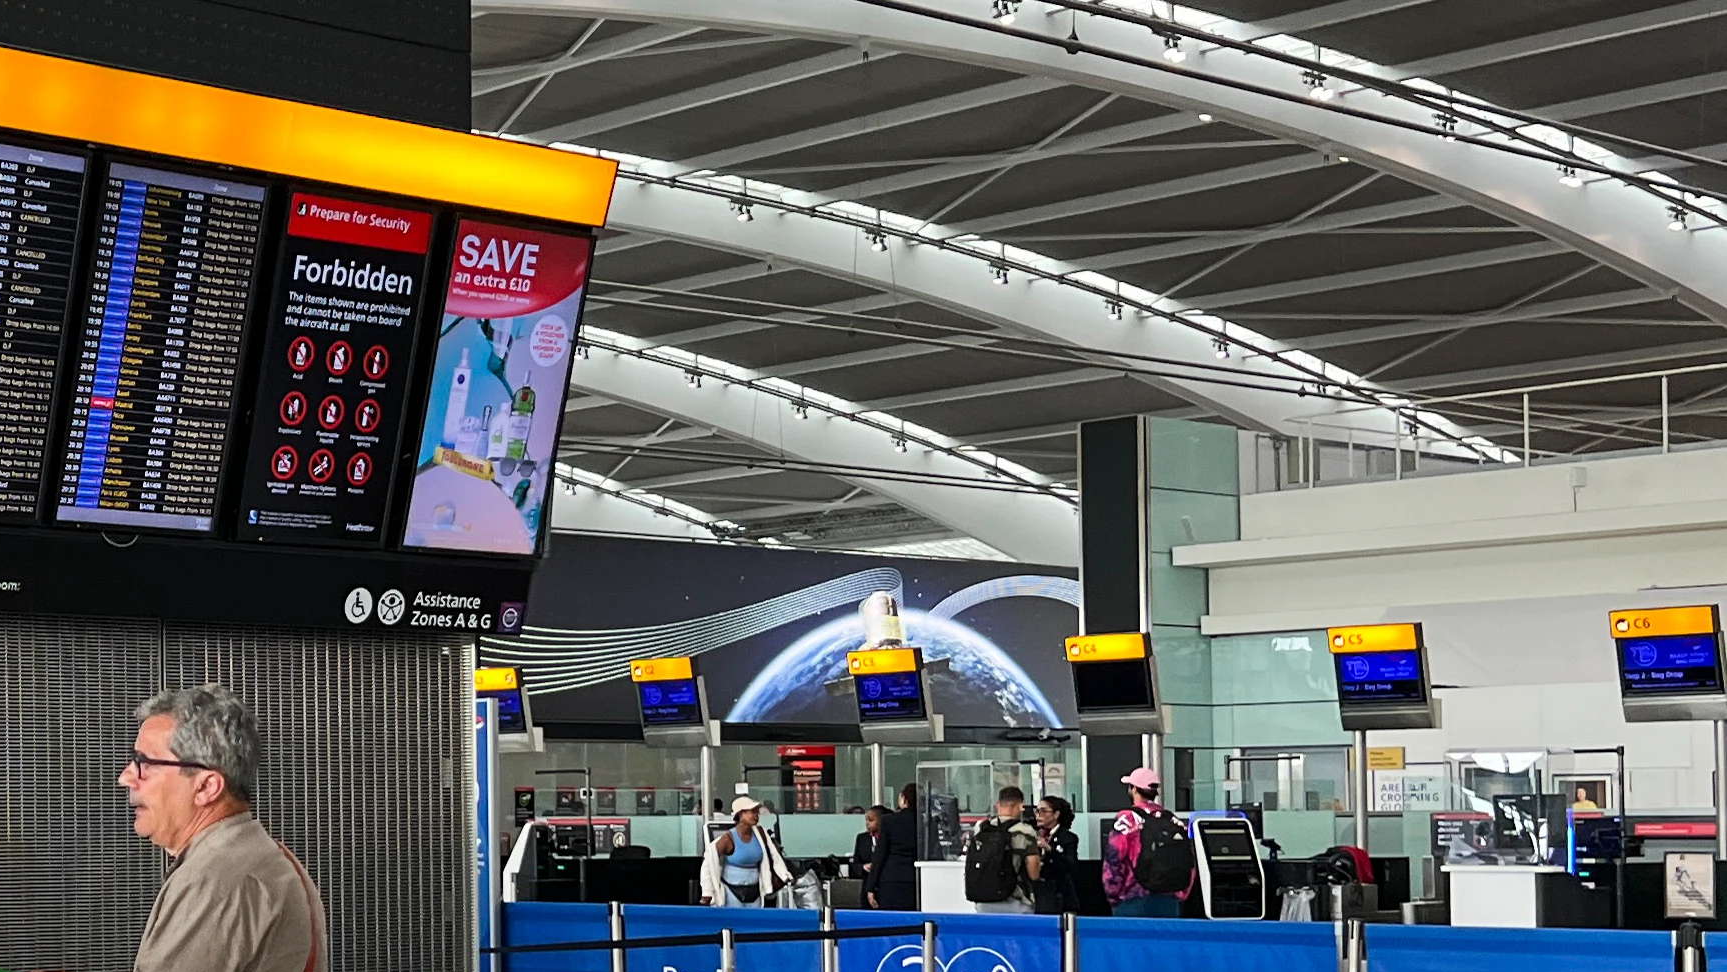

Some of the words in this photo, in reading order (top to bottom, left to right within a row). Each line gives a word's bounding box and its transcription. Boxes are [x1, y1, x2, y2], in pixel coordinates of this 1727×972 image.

[310, 205, 350, 222] Prepare
[353, 211, 367, 224] for
[369, 214, 410, 233] Security
[459, 234, 540, 277] SAVE
[293, 255, 412, 295] Forbidden
[454, 272, 471, 284] an
[473, 274, 506, 290] extra
[509, 278, 531, 292] £10
[289, 291, 303, 302] The
[305, 293, 327, 305] items
[328, 296, 355, 309] shown
[356, 301, 369, 311] are
[370, 303, 411, 316] prohibited
[285, 316, 298, 327] the
[300, 318, 328, 329] aircraft
[330, 322, 339, 331] at
[340, 322, 350, 332] all
[287, 305, 302, 314] and
[304, 307, 331, 318] cannot
[332, 310, 343, 320] be
[344, 311, 366, 322] taken
[367, 315, 378, 324] on
[379, 315, 403, 327] board
[413, 591, 481, 609] Assistance
[411, 611, 452, 627] Zones
[454, 613, 465, 628] A
[468, 614, 477, 628] &
[481, 614, 491, 629] G
[1634, 618, 1650, 629] C6
[1084, 644, 1096, 653] C4
[1349, 634, 1362, 645] C5
[1381, 784, 1400, 792] ARE
